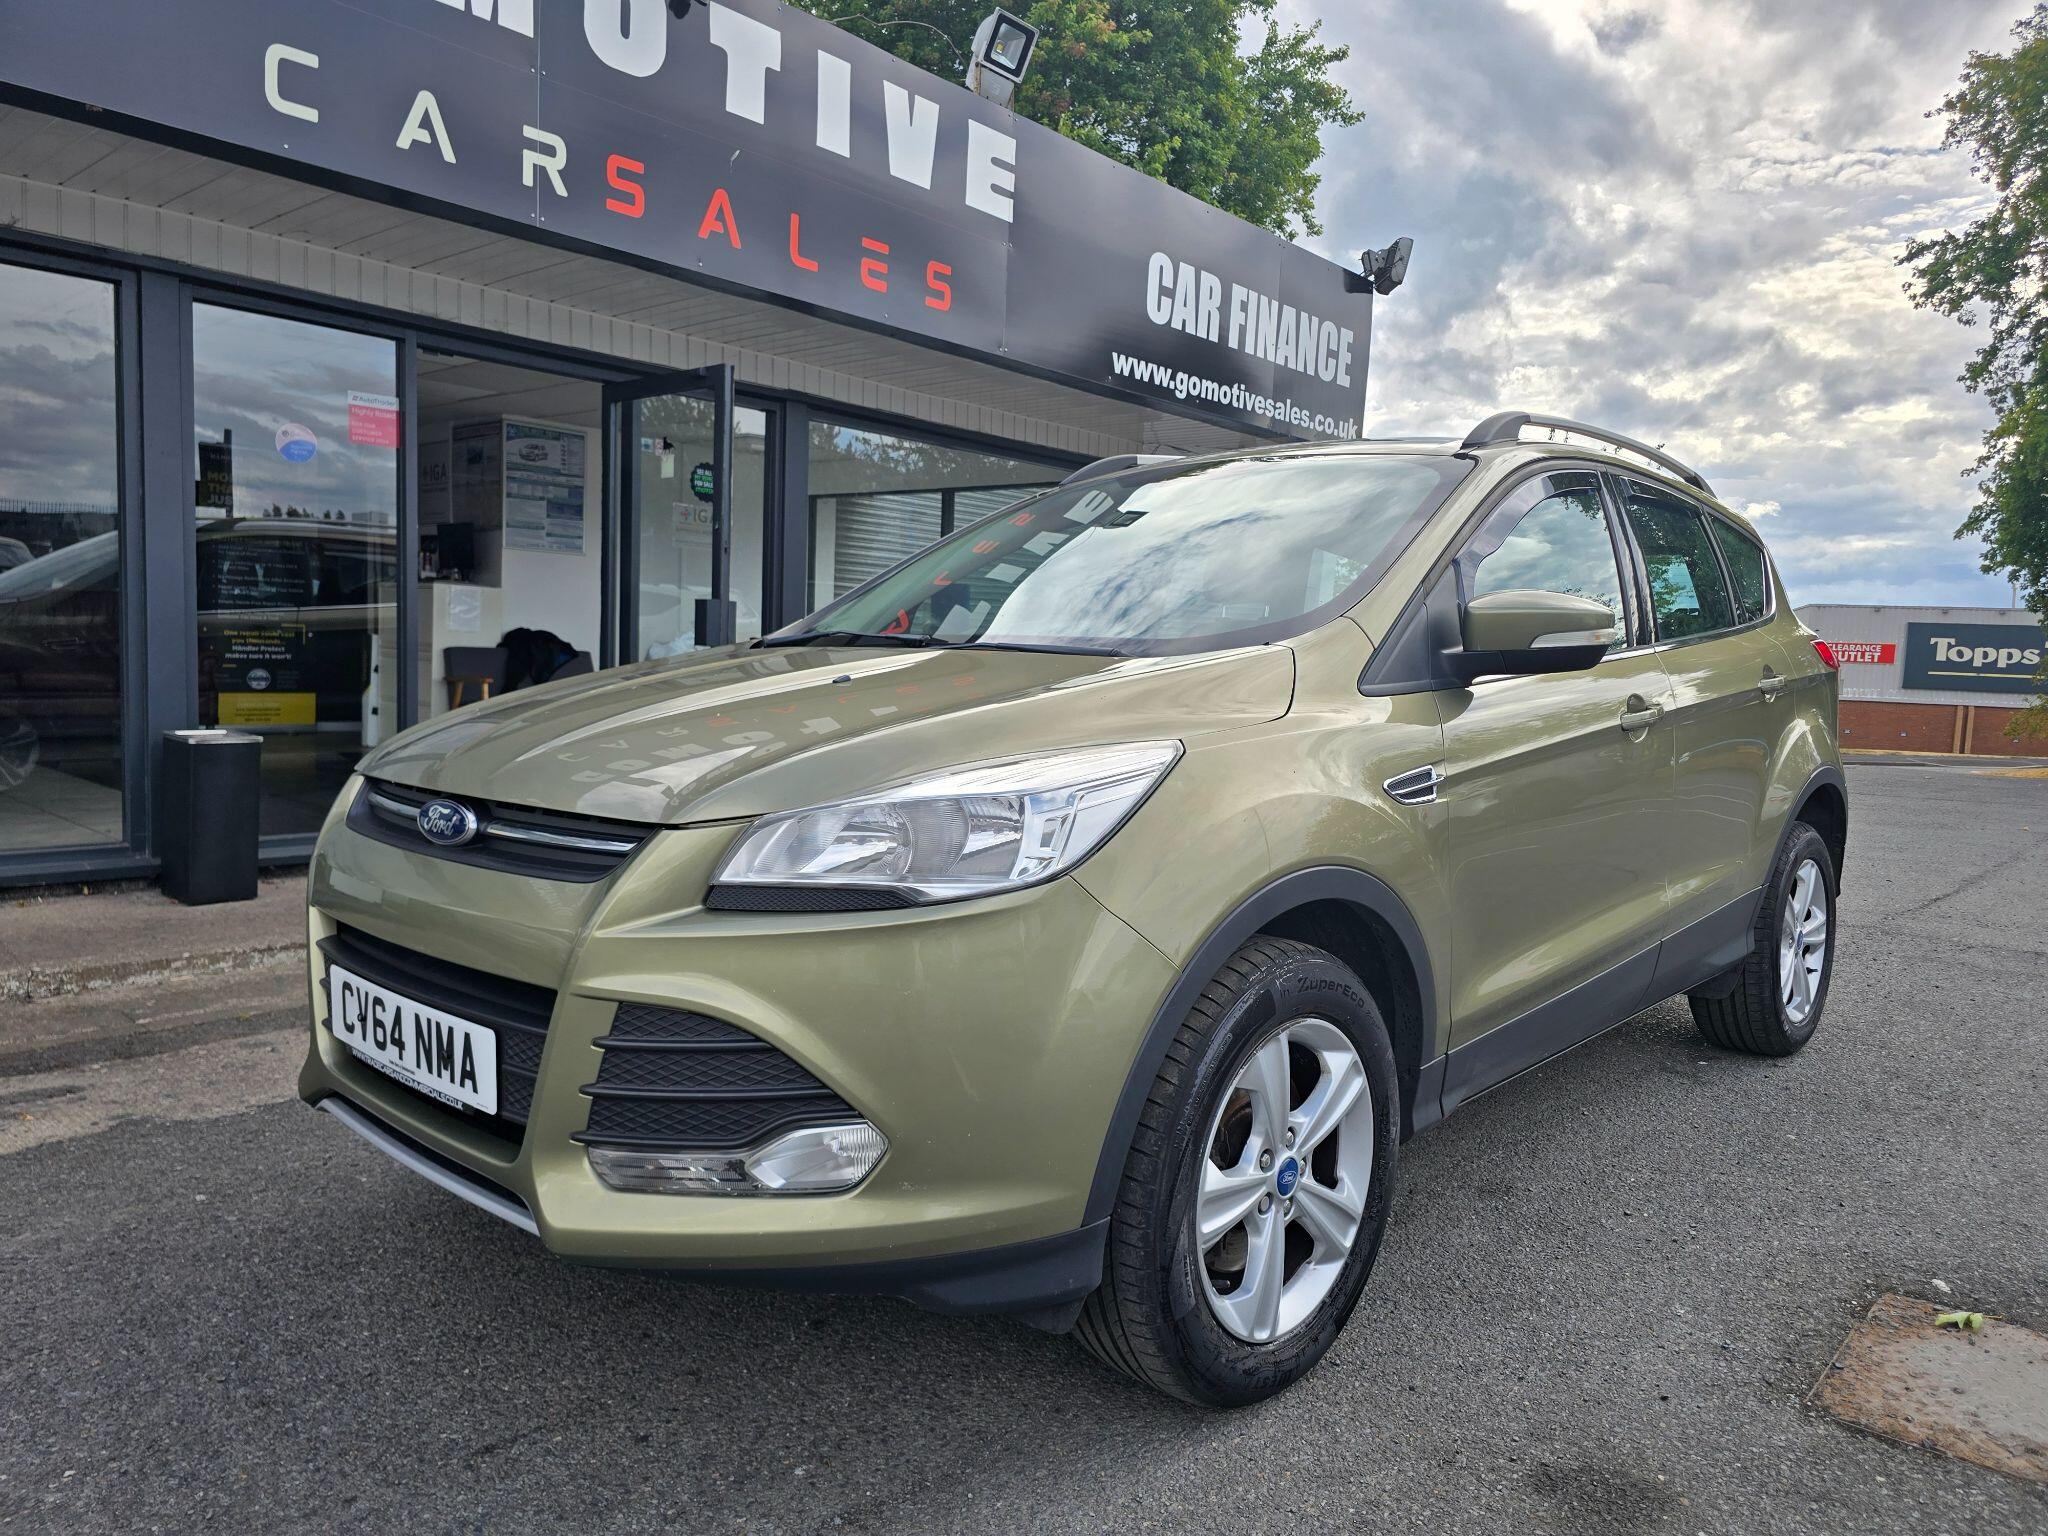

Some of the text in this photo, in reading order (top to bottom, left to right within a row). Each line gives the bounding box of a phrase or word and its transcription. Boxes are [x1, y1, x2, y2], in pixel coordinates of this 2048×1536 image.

[434, 0, 1017, 222] OTIVE
[264, 43, 952, 311] CAR SALES
[1147, 251, 1354, 388] CAR FINANCE
[1112, 351, 1358, 440] www.gomotivesales.co.uk
[1833, 651, 1881, 663] UTLET
[1930, 637, 2041, 668] Topps
[424, 805, 458, 836] Ford
[341, 980, 479, 1094] CV64 NMA
